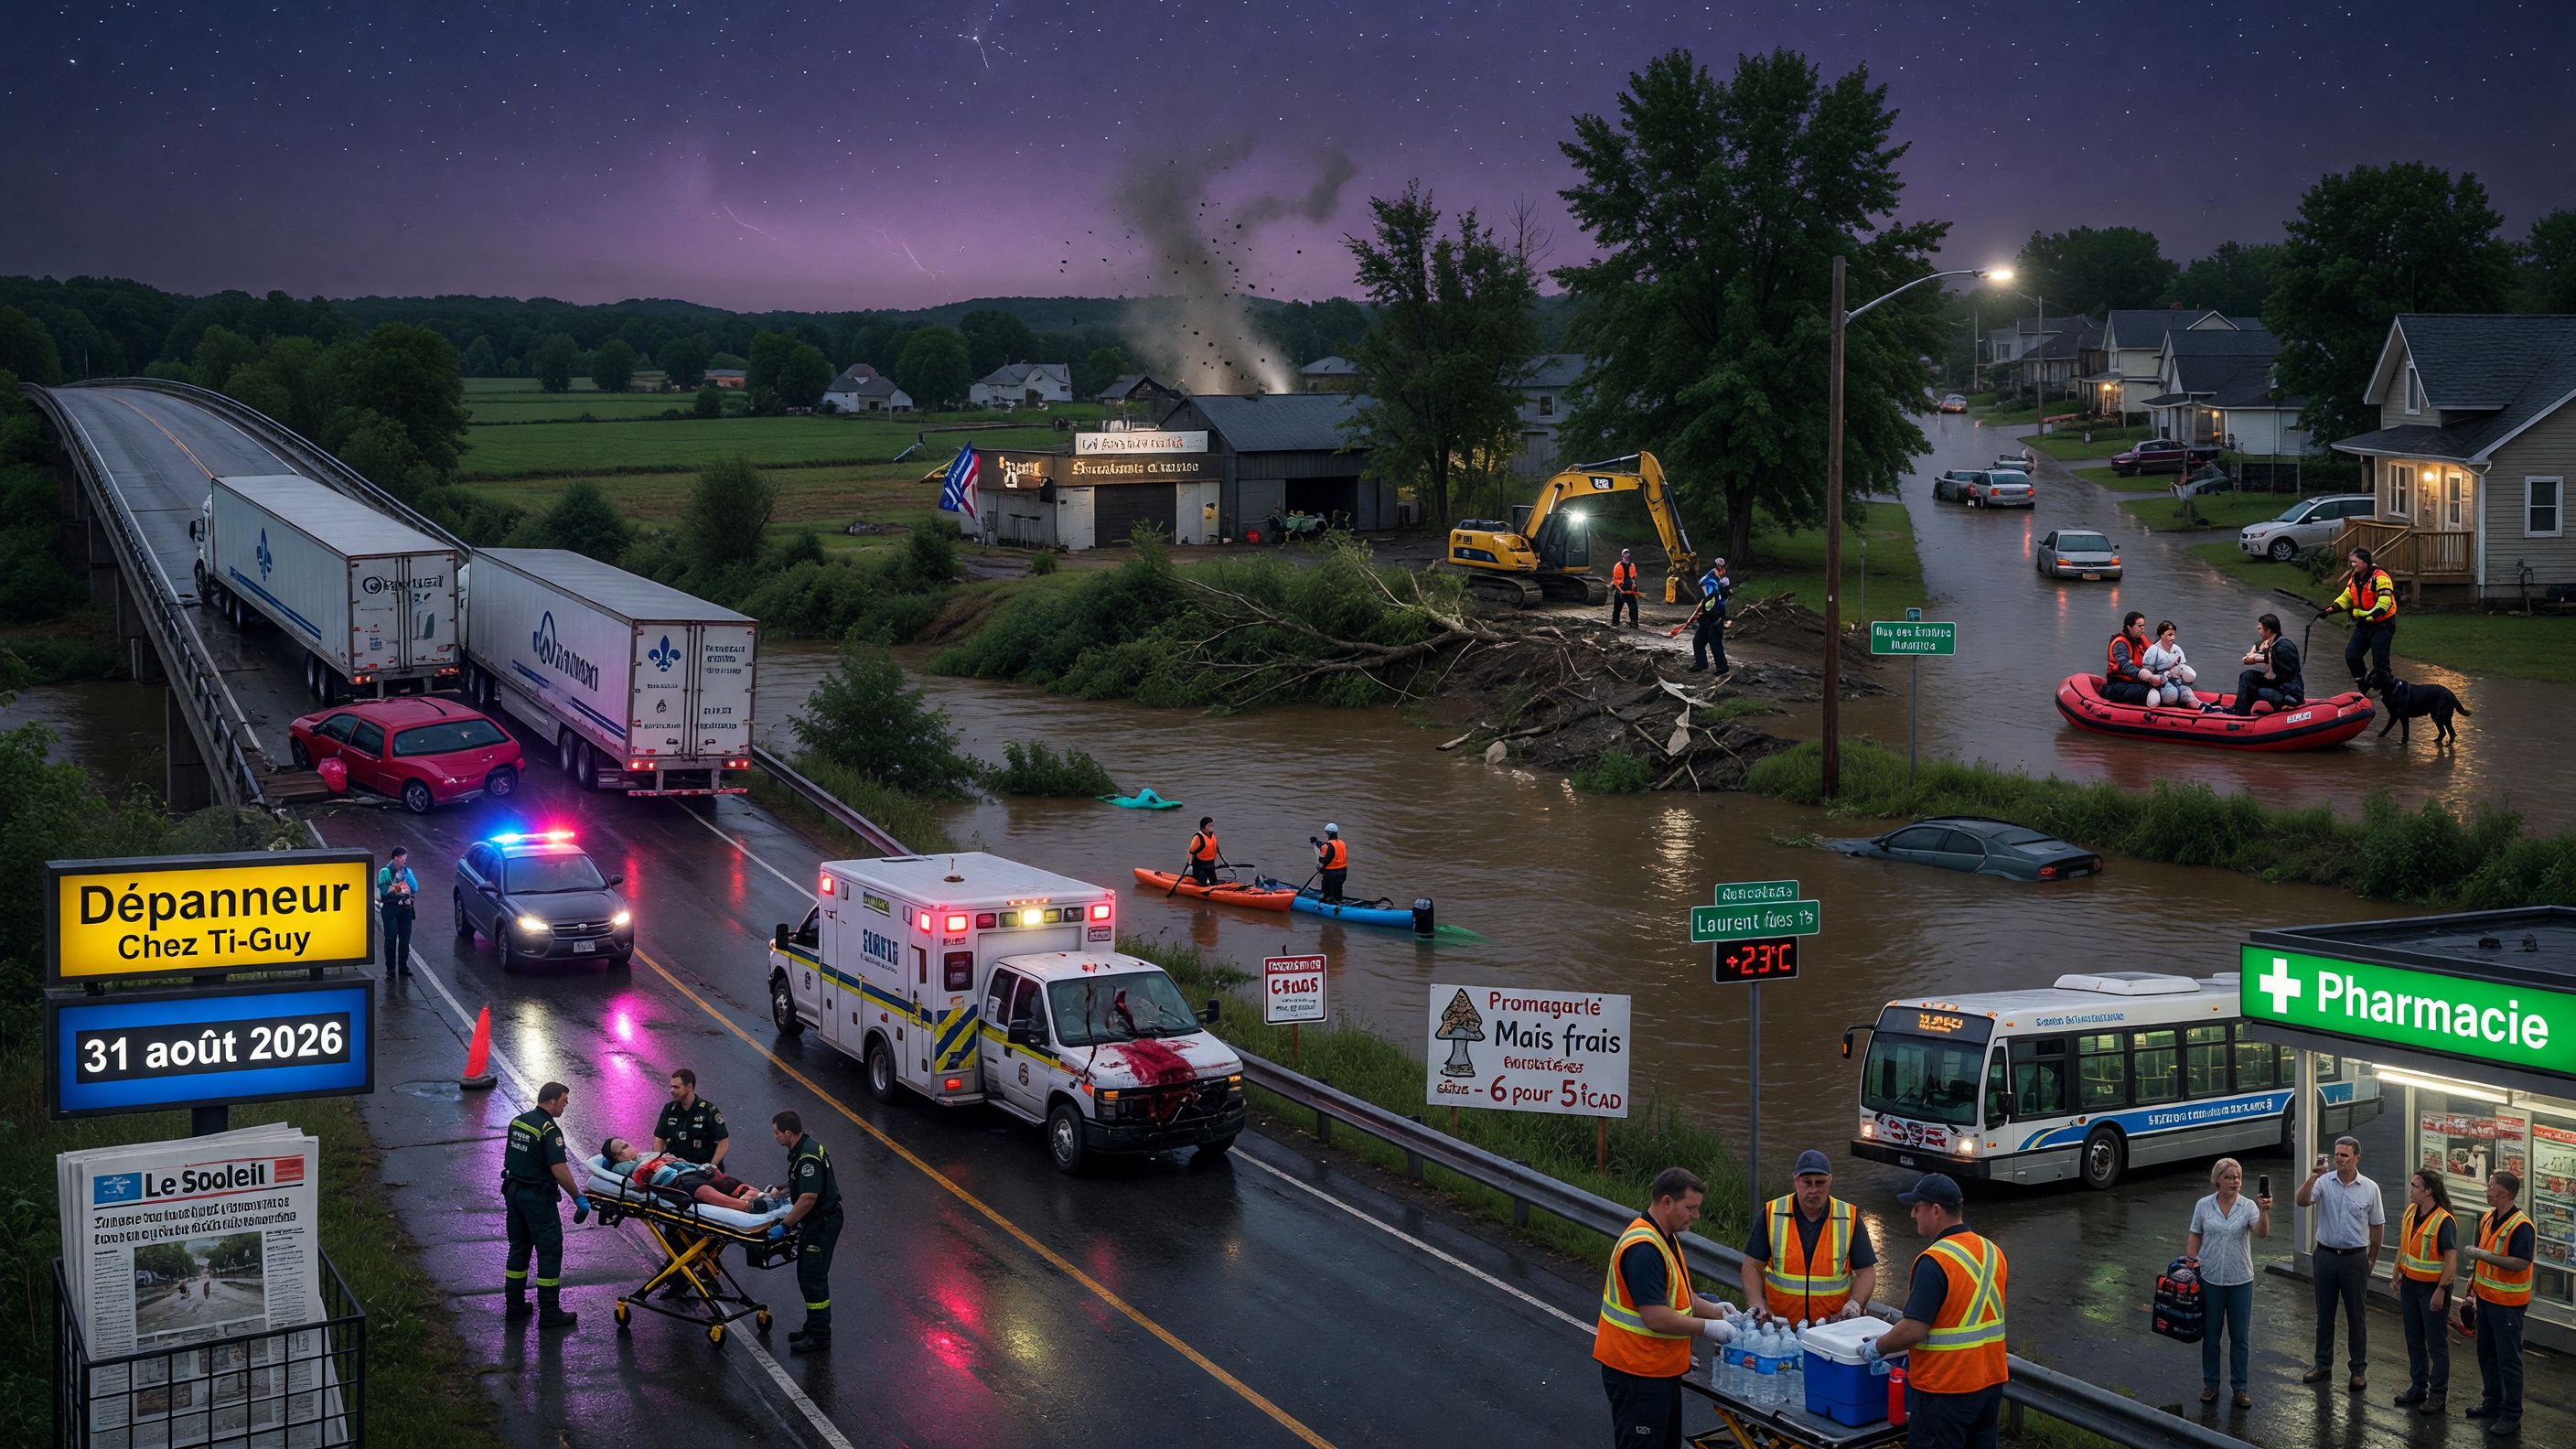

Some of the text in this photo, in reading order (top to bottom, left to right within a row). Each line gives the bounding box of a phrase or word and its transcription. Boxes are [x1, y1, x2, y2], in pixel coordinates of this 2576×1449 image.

[80, 882, 350, 931] Dépanneur
[1698, 914, 1759, 933] Laurent
[118, 927, 311, 960] Chez Ti-Guy
[2318, 971, 2549, 1049] Pharmacie
[83, 1021, 343, 1073] 31 août 2026
[1562, 1023, 1621, 1057] frais
[1490, 1075, 1507, 1102] 6
[1513, 1087, 1553, 1106] pour
[145, 1163, 265, 1197] Le Sooleil
